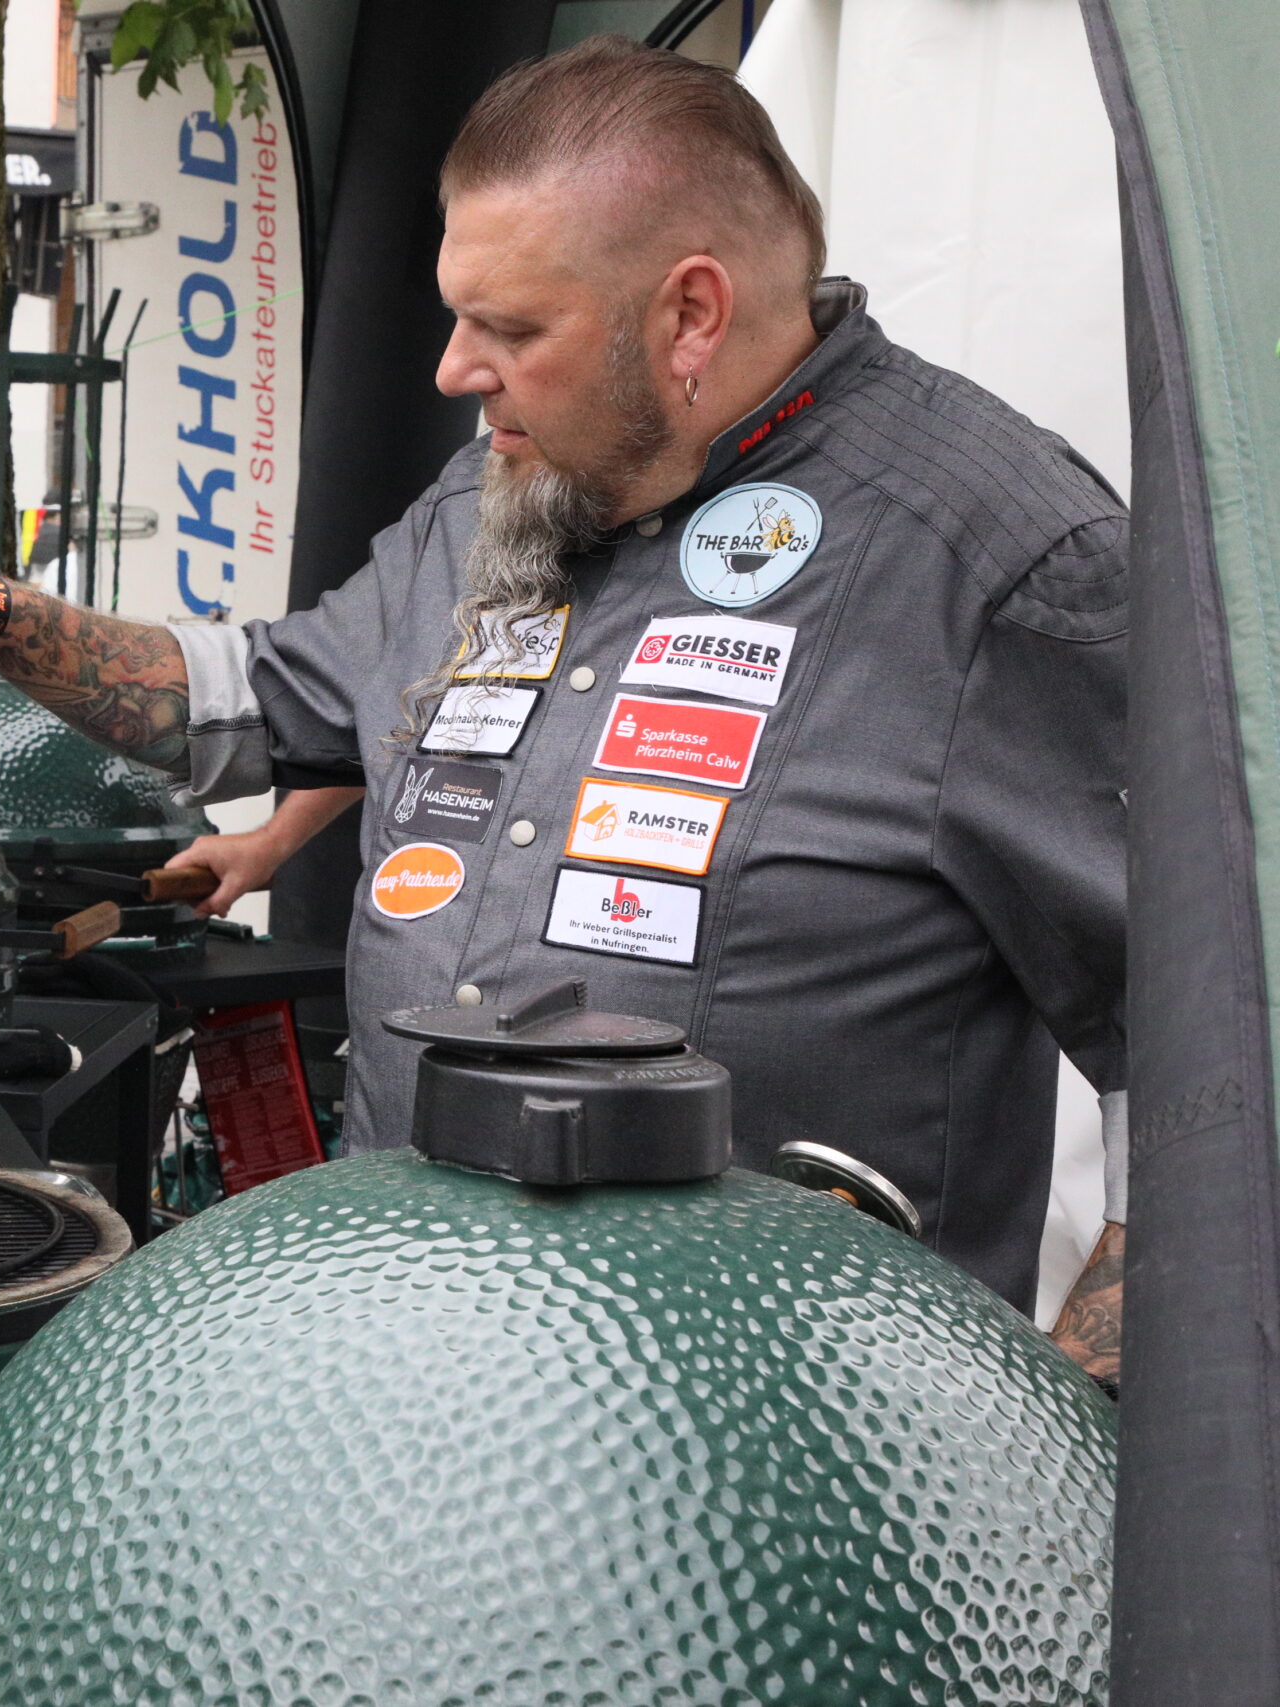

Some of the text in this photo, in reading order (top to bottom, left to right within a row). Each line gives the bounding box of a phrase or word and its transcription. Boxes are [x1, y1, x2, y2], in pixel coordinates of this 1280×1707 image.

[249, 121, 278, 554] Ihr Stuckateurbetrieb
[696, 534, 809, 552] THE BAR Q's
[672, 634, 781, 668] GIESSER
[665, 656, 776, 682] MADE IN GERMANY
[483, 714, 523, 729] Kehrer
[640, 728, 709, 746] Sparkasse
[635, 745, 741, 770] Pforzheim Calw
[422, 789, 494, 812] HASENHEIM
[442, 783, 482, 796] Restaurant
[427, 808, 480, 822] www.hasenheim.de
[627, 810, 709, 837] RAMSTER
[376, 869, 461, 893] easy-Patches.de
[601, 897, 653, 919] Beßler
[569, 919, 677, 944] Ihr Weber Grillspezialist
[590, 936, 599, 945] in
